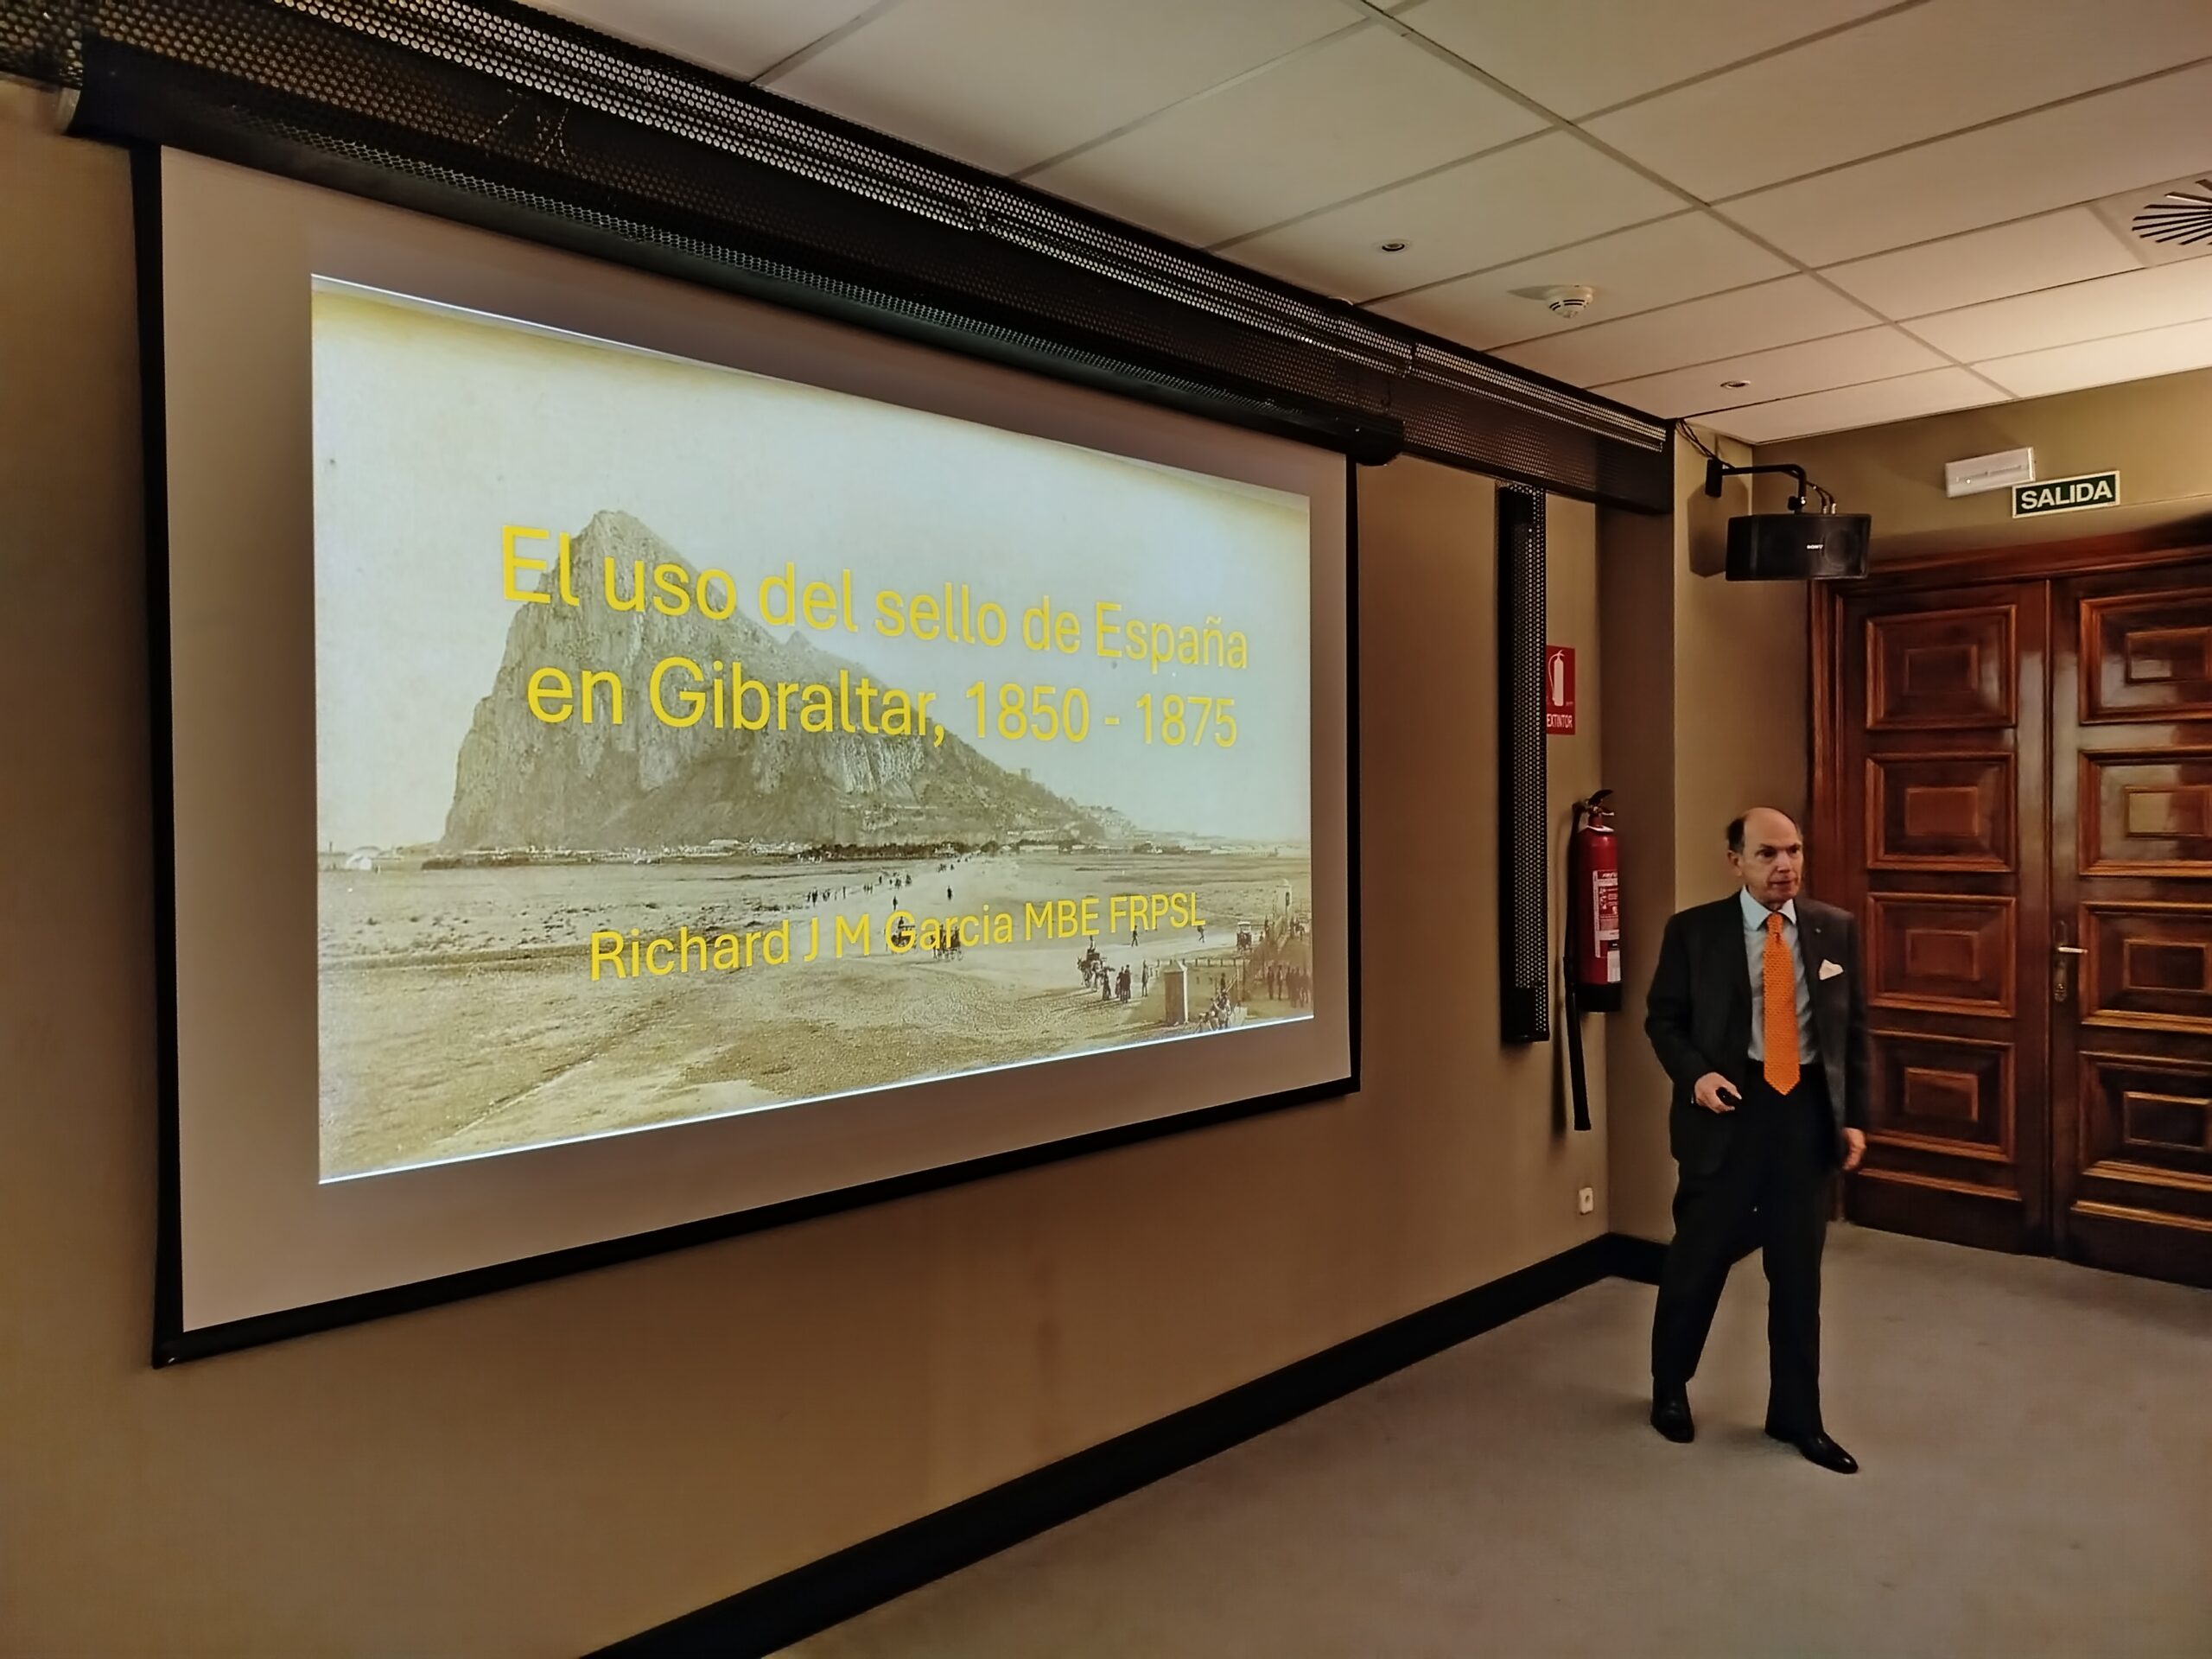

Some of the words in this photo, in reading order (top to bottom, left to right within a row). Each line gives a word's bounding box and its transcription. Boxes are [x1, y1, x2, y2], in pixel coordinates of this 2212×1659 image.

[2021, 480, 2113, 510] SALIDA
[502, 524, 580, 607] El
[604, 555, 737, 620] uso
[759, 562, 858, 632] del
[874, 582, 1007, 646] sello
[1022, 595, 1080, 654] de
[1096, 601, 1249, 675] España
[527, 664, 624, 726] en
[649, 657, 946, 748] Gibraltar,
[966, 681, 1090, 743] 1850
[1136, 693, 1237, 748] 1875
[1547, 714, 1573, 728] EXTINTOR
[590, 918, 789, 982] Richard
[803, 917, 818, 962] J
[836, 913, 870, 958] M
[884, 905, 1013, 953] Garcia
[1025, 898, 1099, 941] MBE
[1109, 892, 1206, 933] FRPSL
